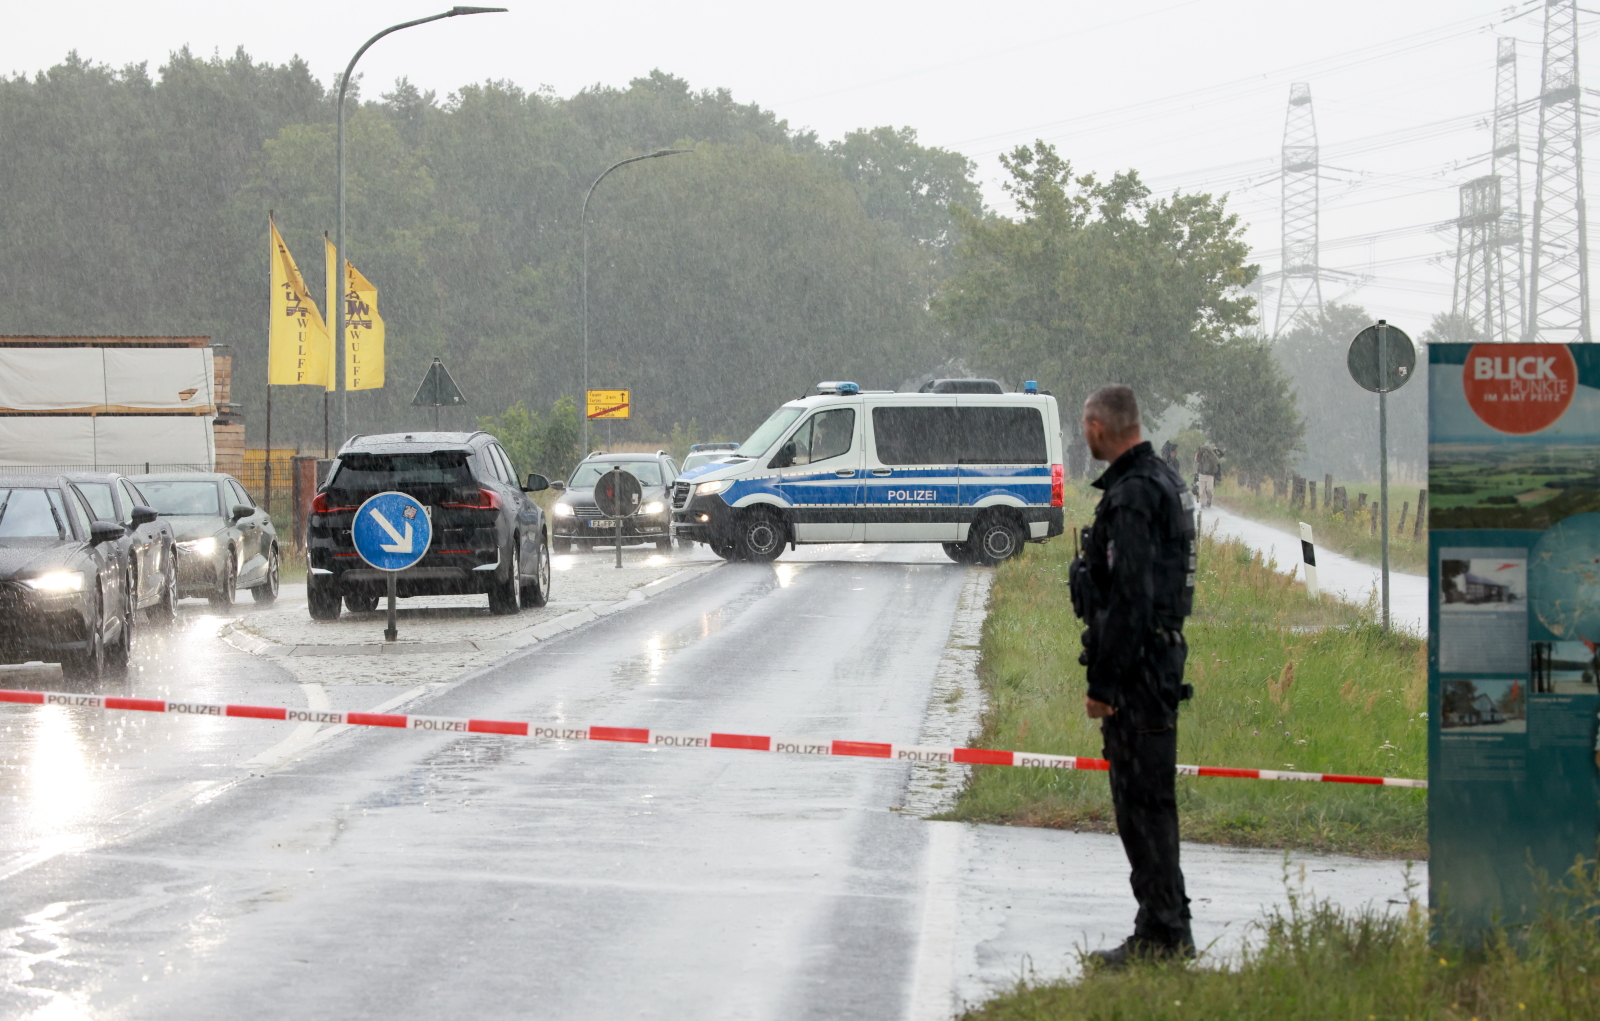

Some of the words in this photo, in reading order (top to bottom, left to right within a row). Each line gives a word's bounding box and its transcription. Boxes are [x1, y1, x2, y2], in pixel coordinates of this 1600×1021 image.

[297, 318, 308, 382] WULFF
[350, 330, 361, 388] WULFF
[1474, 356, 1557, 380] BLICK
[1510, 379, 1568, 395] PUNKTE
[1483, 394, 1498, 402] IM
[1502, 394, 1525, 402] AMT
[1530, 394, 1561, 402] PEITZ
[887, 489, 937, 501] POLIZEI
[48, 694, 101, 708] POLIZEI
[168, 702, 221, 716] POLIZEI
[288, 711, 343, 725] POLIZEI
[413, 718, 466, 732] POLIZEI
[535, 727, 588, 740] POLIZEI
[655, 734, 708, 748] POLIZEI
[776, 742, 830, 755] POLIZEI
[898, 750, 952, 763] POLIZEI
[1021, 757, 1076, 769] POLIZEI
